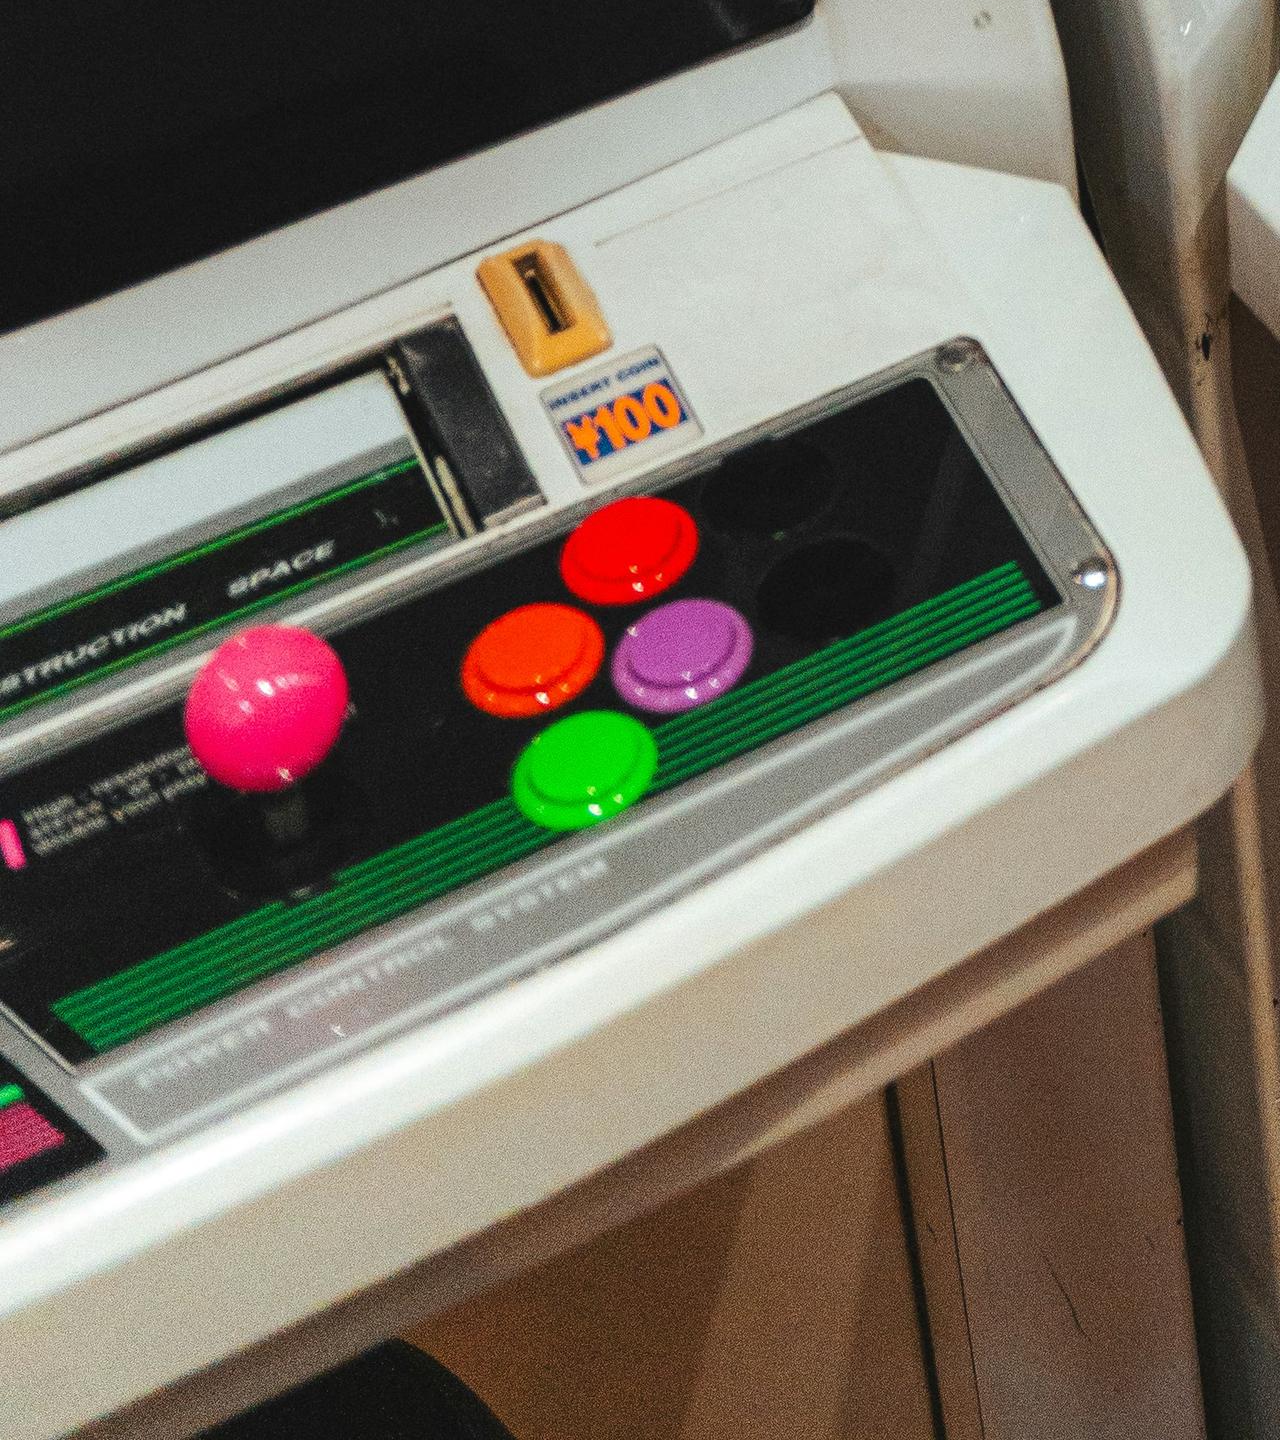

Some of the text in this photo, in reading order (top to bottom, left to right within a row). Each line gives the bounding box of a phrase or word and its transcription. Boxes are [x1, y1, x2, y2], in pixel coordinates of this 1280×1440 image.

[548, 356, 661, 411] INSERT COIN
[566, 381, 682, 461] ¥100
[227, 536, 336, 601] SPACE
[288, 932, 446, 1020] CONTROL
[466, 856, 610, 932] SYSTEM
